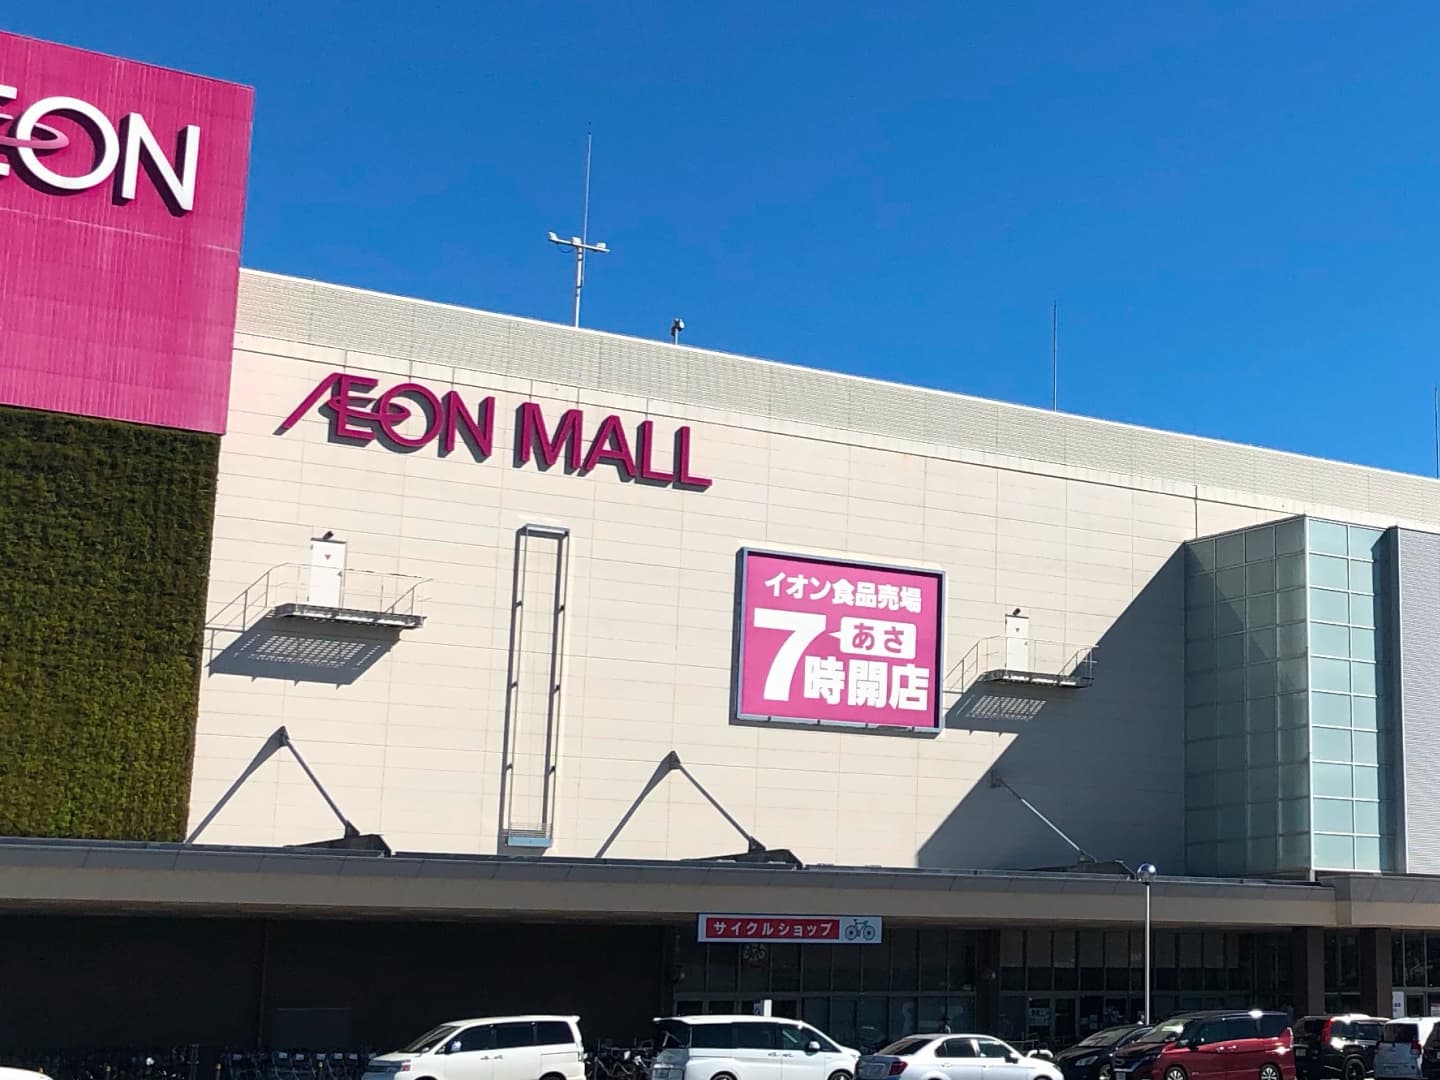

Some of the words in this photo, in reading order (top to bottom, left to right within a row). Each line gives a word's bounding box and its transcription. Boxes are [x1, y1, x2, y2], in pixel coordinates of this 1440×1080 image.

[516, 401, 712, 491] MALL
[764, 572, 922, 614] イオン食品売場
[852, 622, 905, 653] あさ
[713, 920, 834, 937] サイクルショップ
